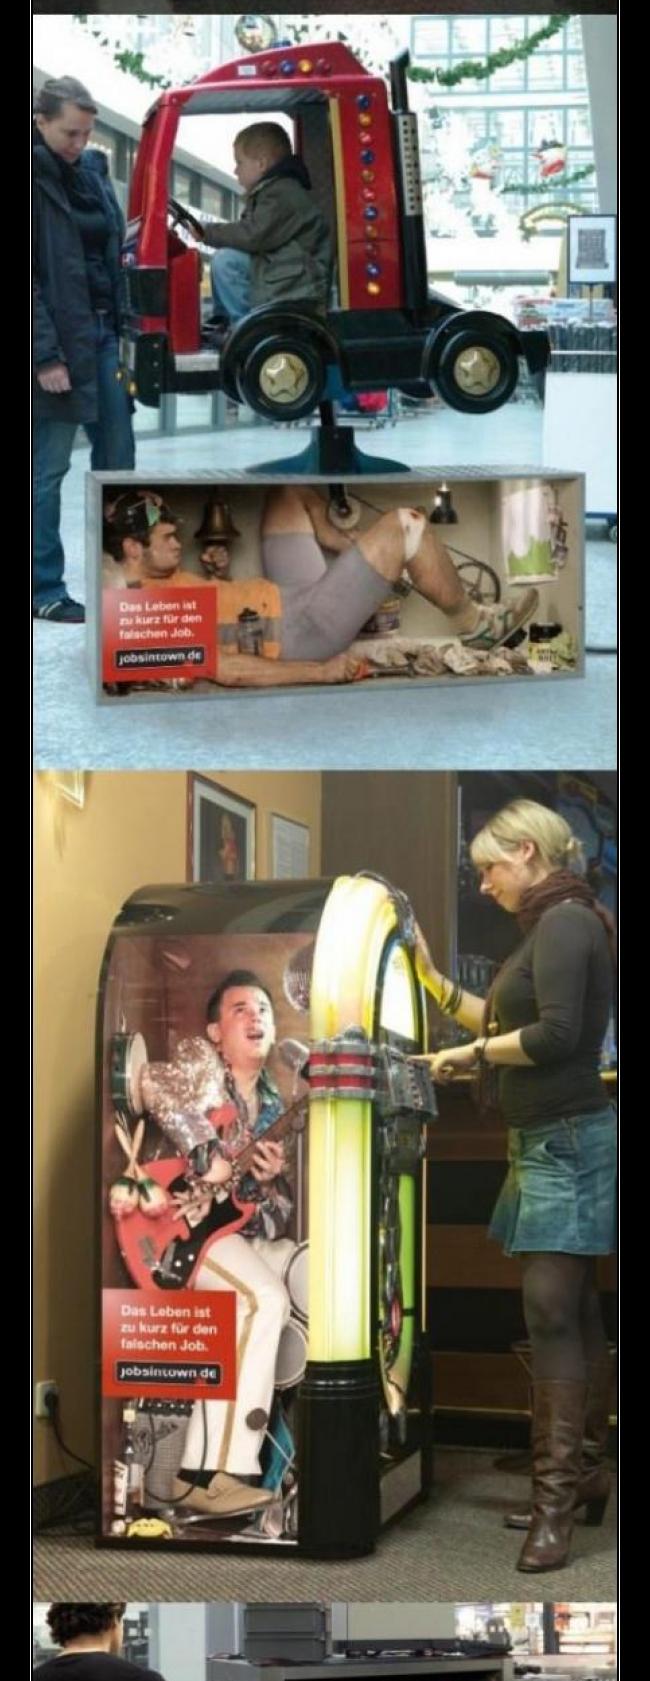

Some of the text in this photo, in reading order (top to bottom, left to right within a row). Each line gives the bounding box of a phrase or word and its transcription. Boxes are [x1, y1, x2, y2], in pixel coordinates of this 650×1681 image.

[120, 601, 197, 612] Das Leben ist
[120, 614, 202, 625] zu kurz für den
[120, 628, 195, 639] falschen Job.
[121, 1305, 210, 1318] Das Leben ist
[121, 1322, 217, 1334] zu kurz für den
[121, 1338, 208, 1351] falschen Job.
